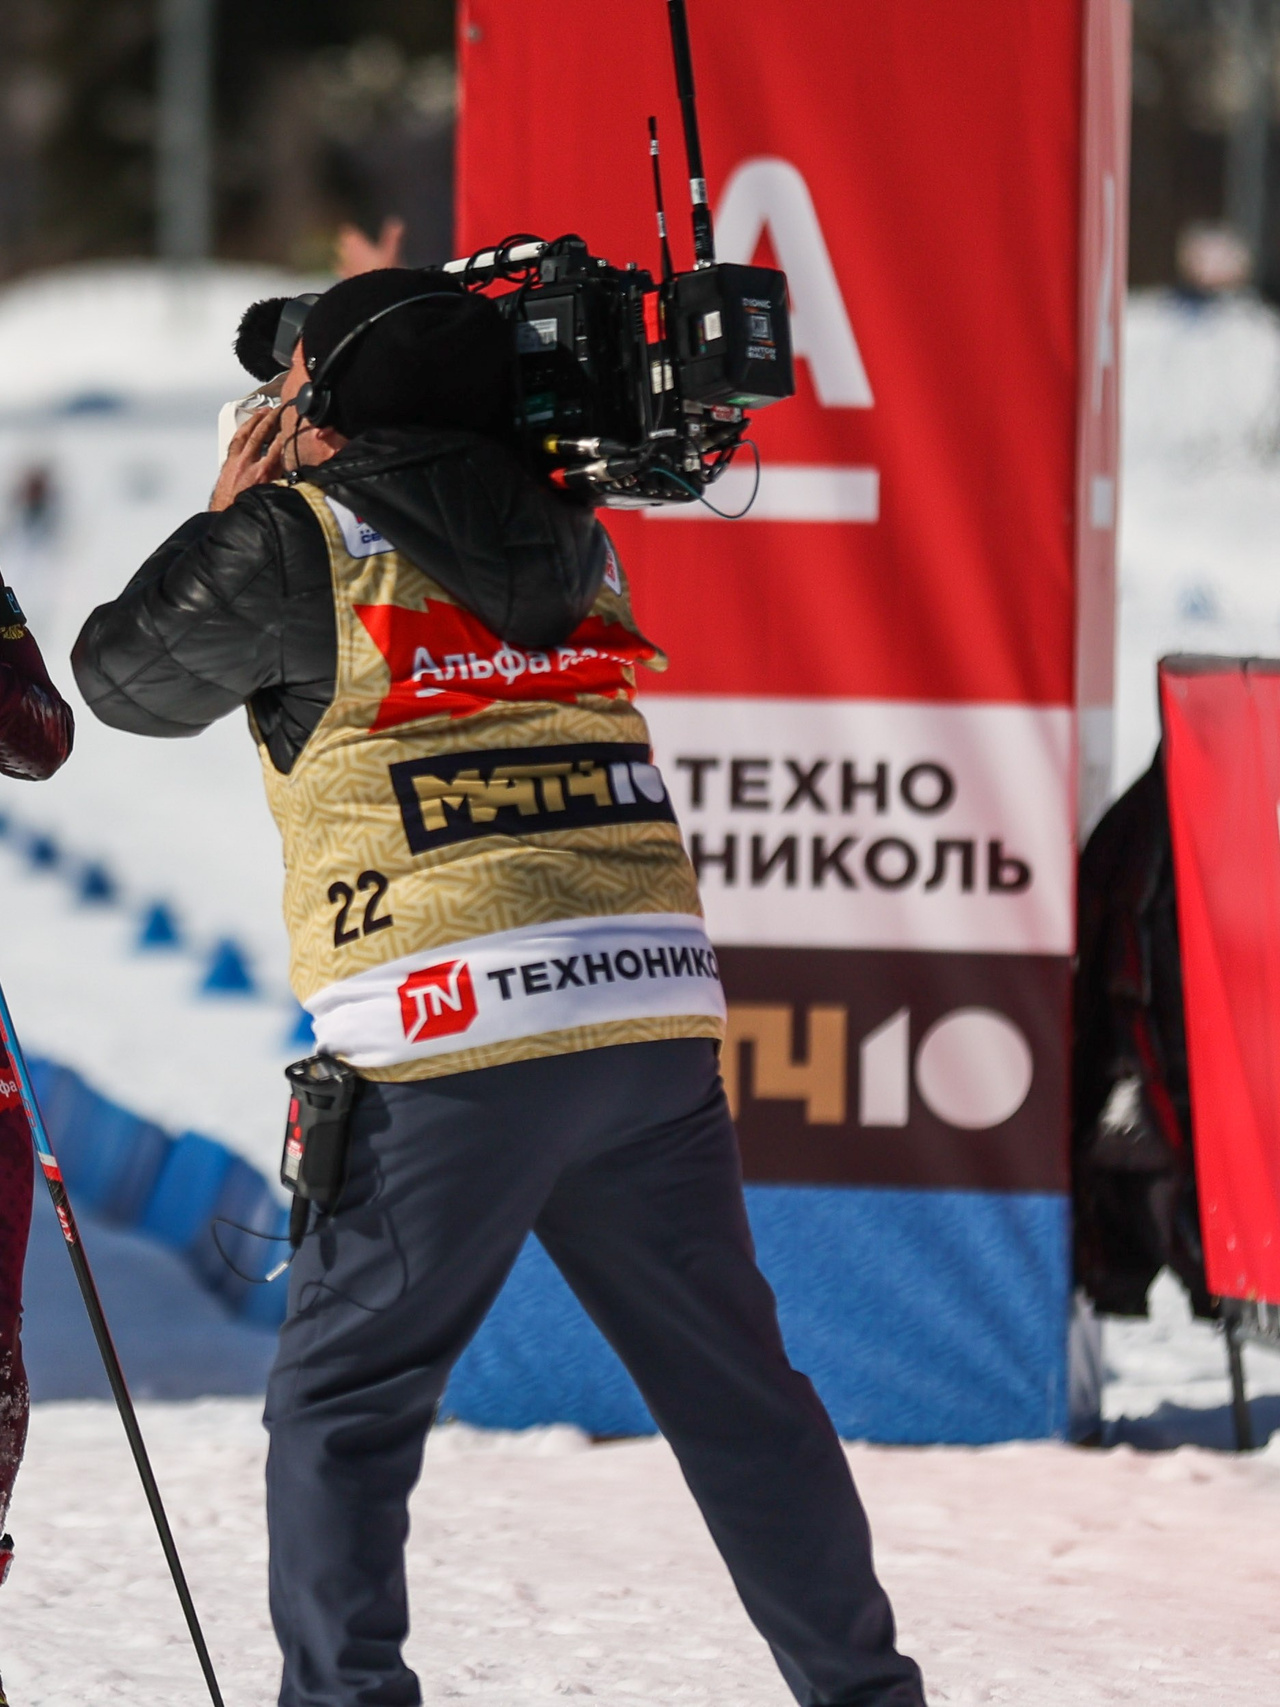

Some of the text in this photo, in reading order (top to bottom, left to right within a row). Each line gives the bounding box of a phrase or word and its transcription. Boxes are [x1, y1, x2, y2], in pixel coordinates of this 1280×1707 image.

[411, 641, 553, 686] Альфа
[675, 756, 958, 817] ТЕХНО
[690, 832, 1033, 896] НИКОЛЬ
[327, 869, 394, 949] 22
